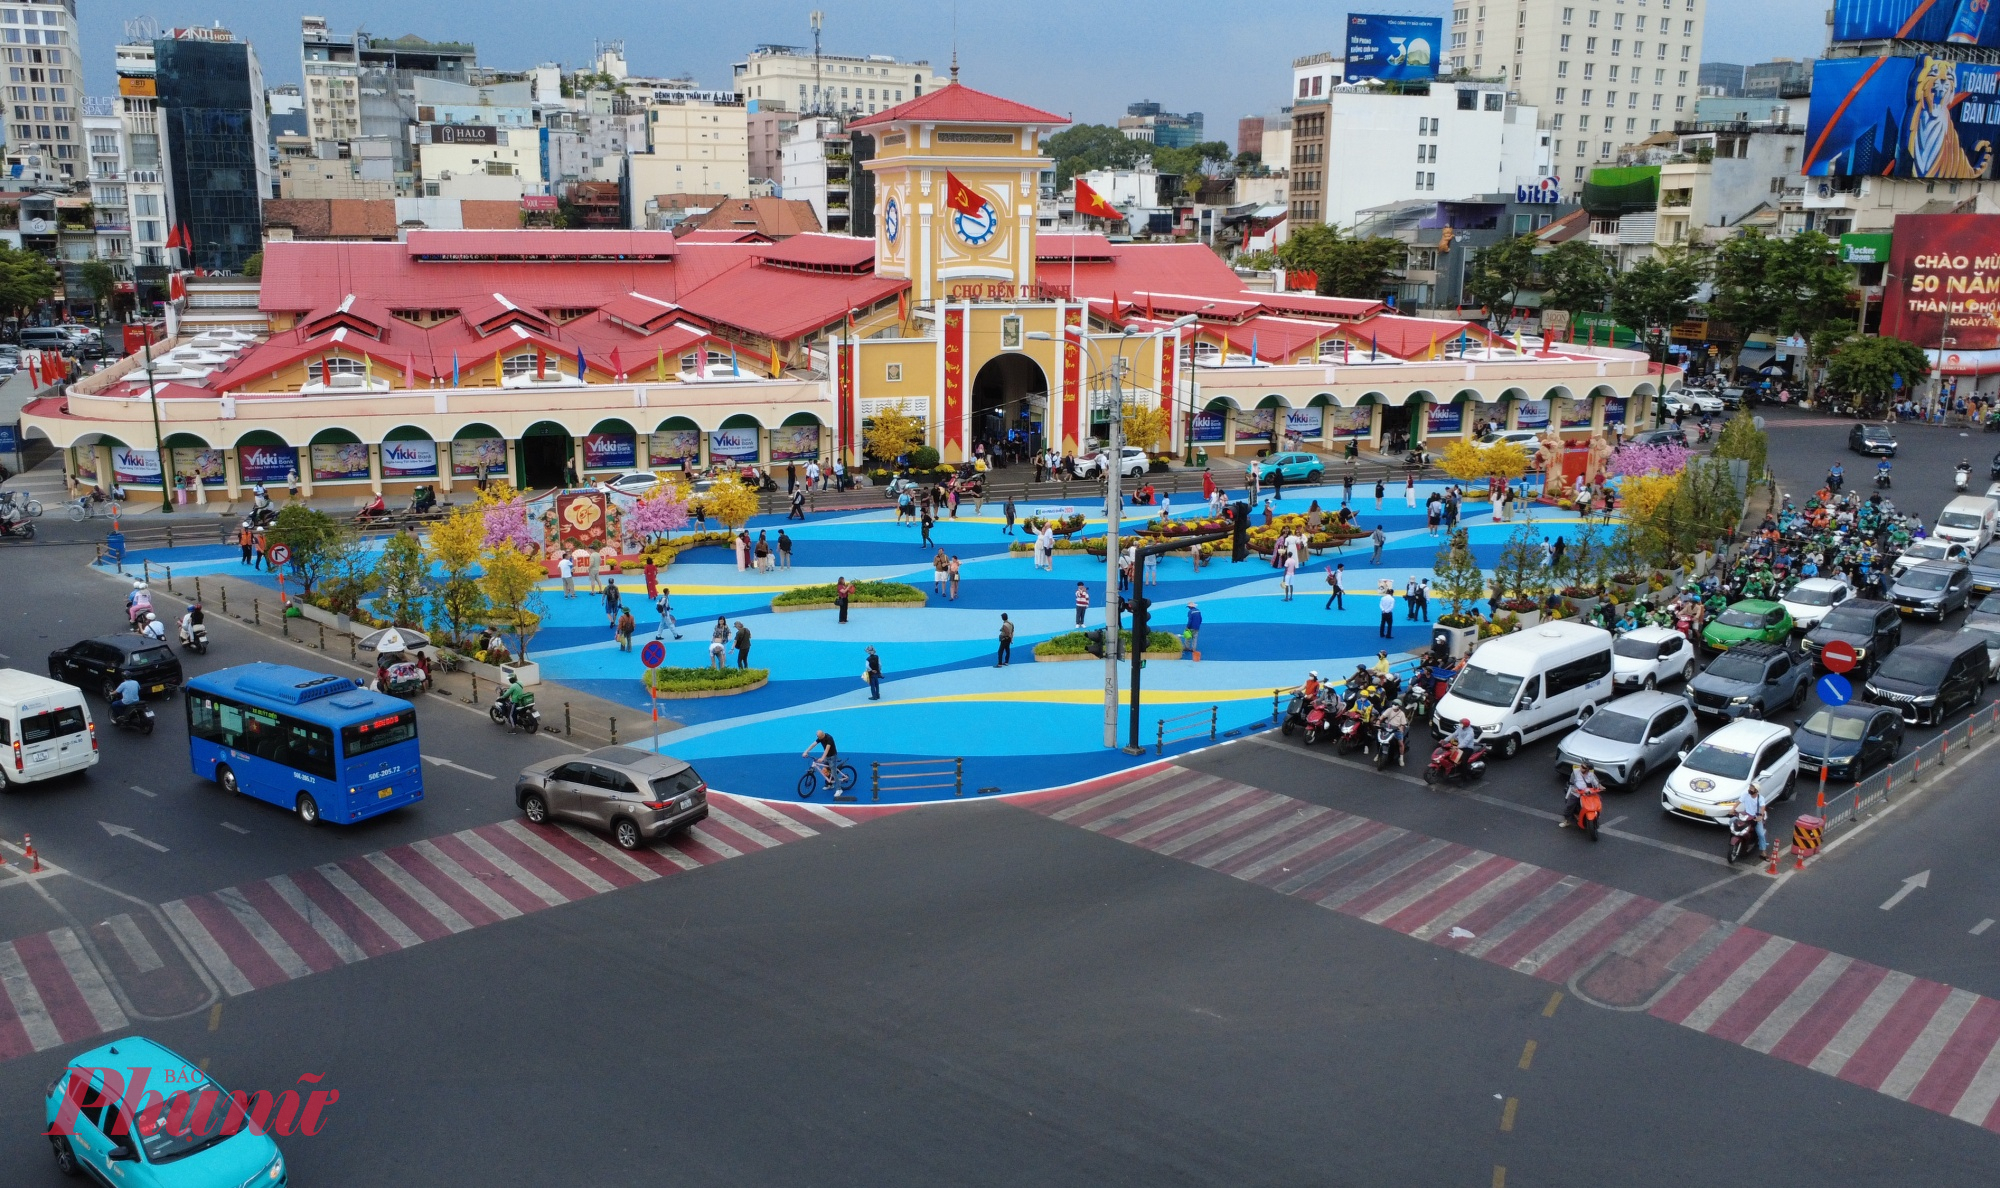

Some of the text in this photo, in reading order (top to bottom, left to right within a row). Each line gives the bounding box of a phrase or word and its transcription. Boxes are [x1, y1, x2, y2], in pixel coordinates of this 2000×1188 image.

[162, 27, 213, 40] AVANTI
[1387, 37, 1430, 67] 30
[457, 129, 486, 138] HALO
[1850, 246, 1876, 255] Locker
[1915, 252, 1969, 269] CHÀO
[952, 283, 982, 299] CHỢ
[987, 280, 1015, 298] BẾN
[1911, 271, 2000, 294] 50 NĂM
[1909, 298, 1964, 313] THÀNH
[1950, 317, 1981, 326] NGÀY
[1428, 406, 1449, 419] Vikki
[1518, 402, 1538, 415] Vikki
[1287, 410, 1308, 423] Vikki
[588, 436, 616, 452] Vikki
[713, 431, 740, 446] Vikki
[118, 449, 144, 466] Vikki
[244, 448, 278, 466] Vikki
[385, 444, 416, 460] Vikki
